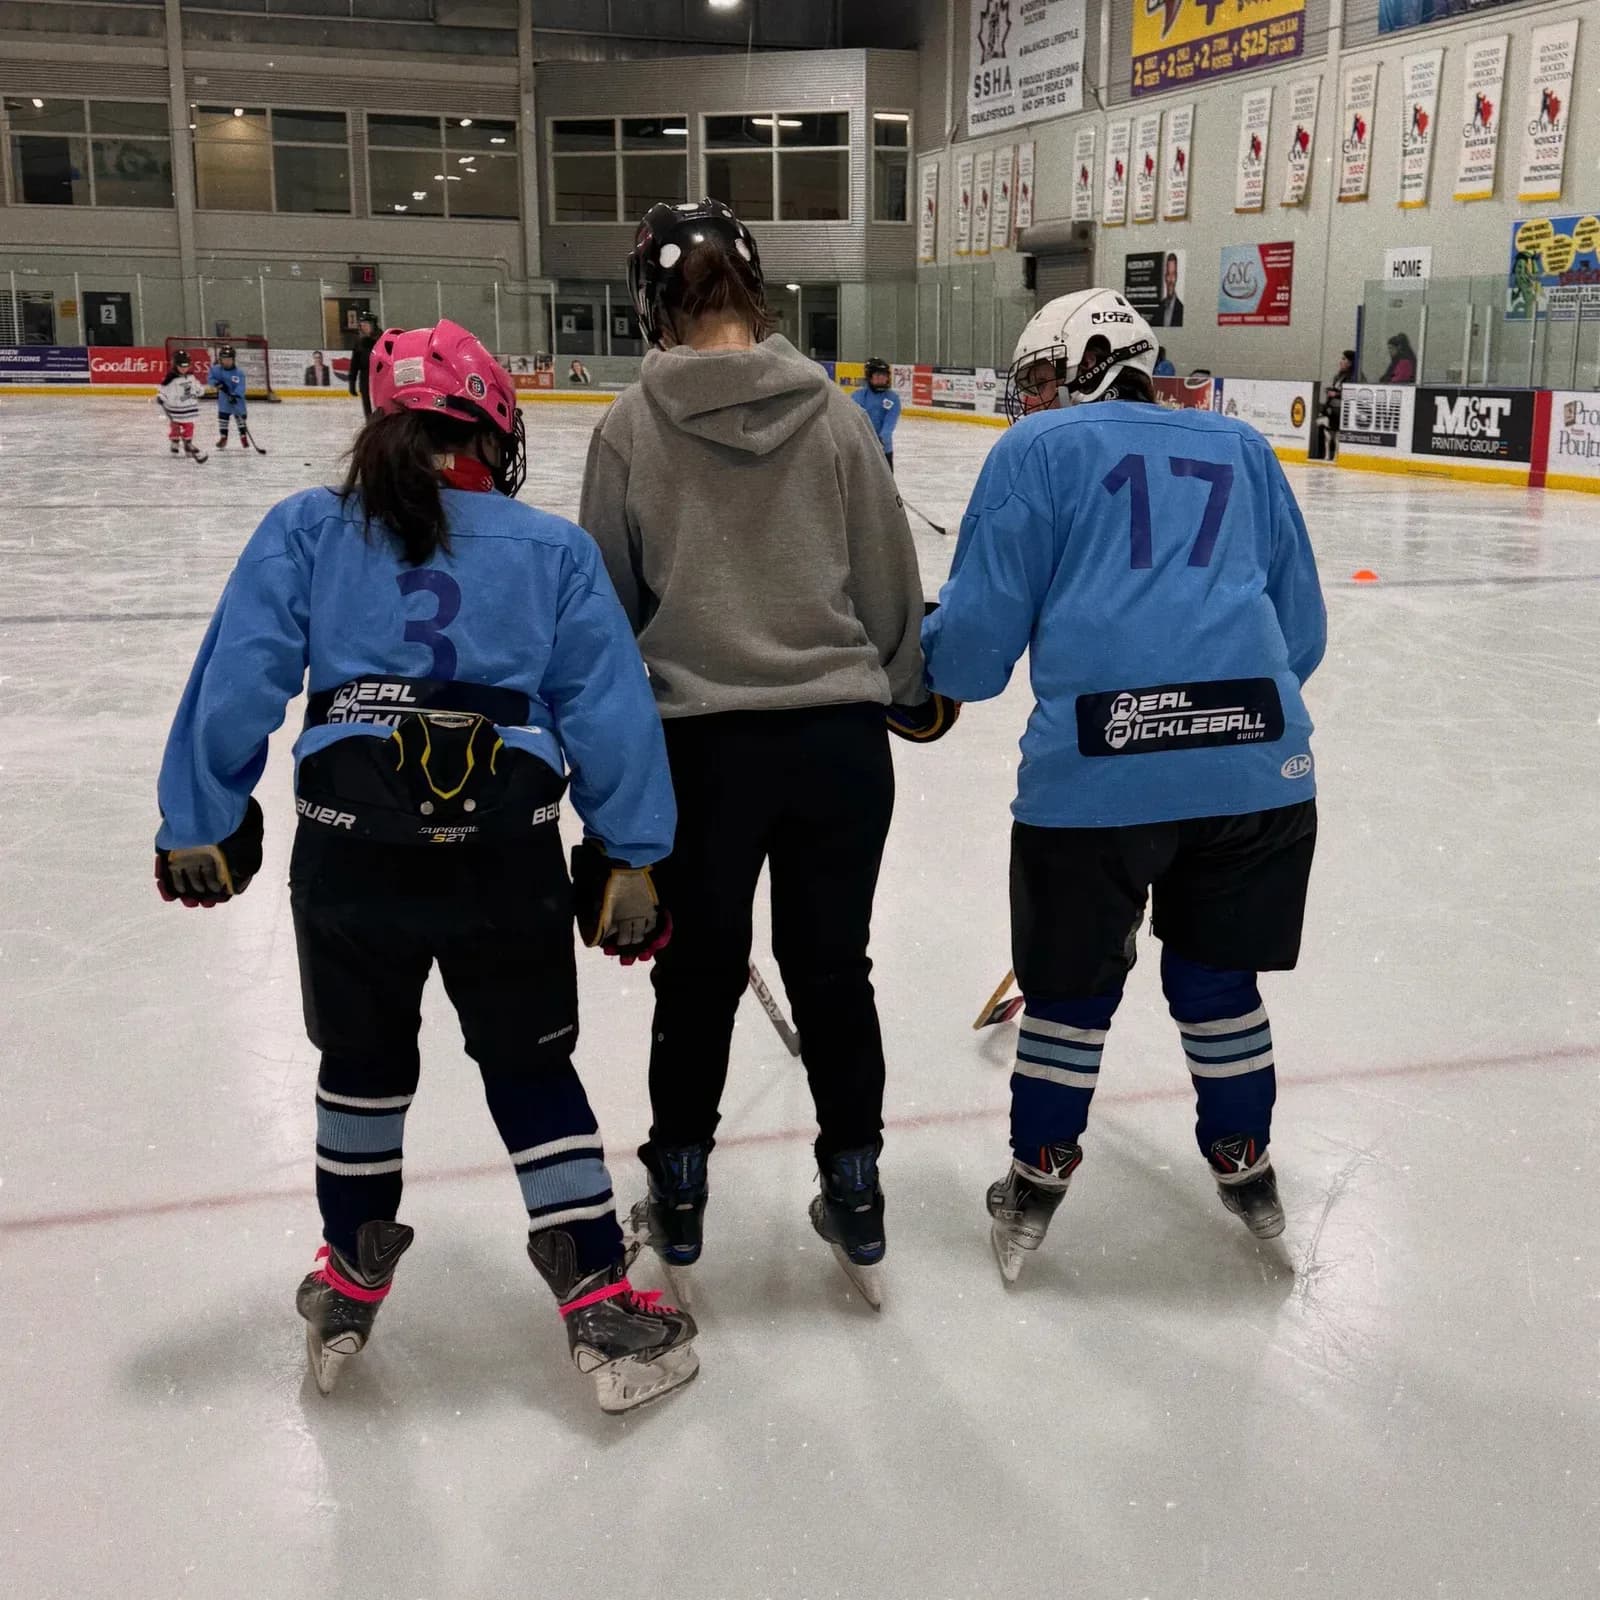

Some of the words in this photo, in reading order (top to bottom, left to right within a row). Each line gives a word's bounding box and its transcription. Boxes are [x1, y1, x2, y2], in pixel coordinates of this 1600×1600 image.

[1134, 62, 1142, 86] 2
[1240, 28, 1268, 62] $25
[974, 65, 1012, 98] SSHA
[1228, 261, 1255, 284] GSC
[1393, 260, 1422, 278] HOME
[105, 308, 112, 320] 2
[1092, 312, 1134, 324] JOFA
[91, 358, 148, 373] GoodLife
[1432, 396, 1512, 438] M&T
[1432, 437, 1469, 452] PRINTING
[1470, 439, 1500, 454] GROUP
[1101, 453, 1234, 569] 17
[396, 568, 462, 681] 3
[1111, 692, 1193, 721] REAL
[1105, 713, 1266, 749] PICKLEBALL
[297, 798, 356, 830] AUER
[418, 826, 480, 834] SUPREME
[430, 834, 466, 842] S27
